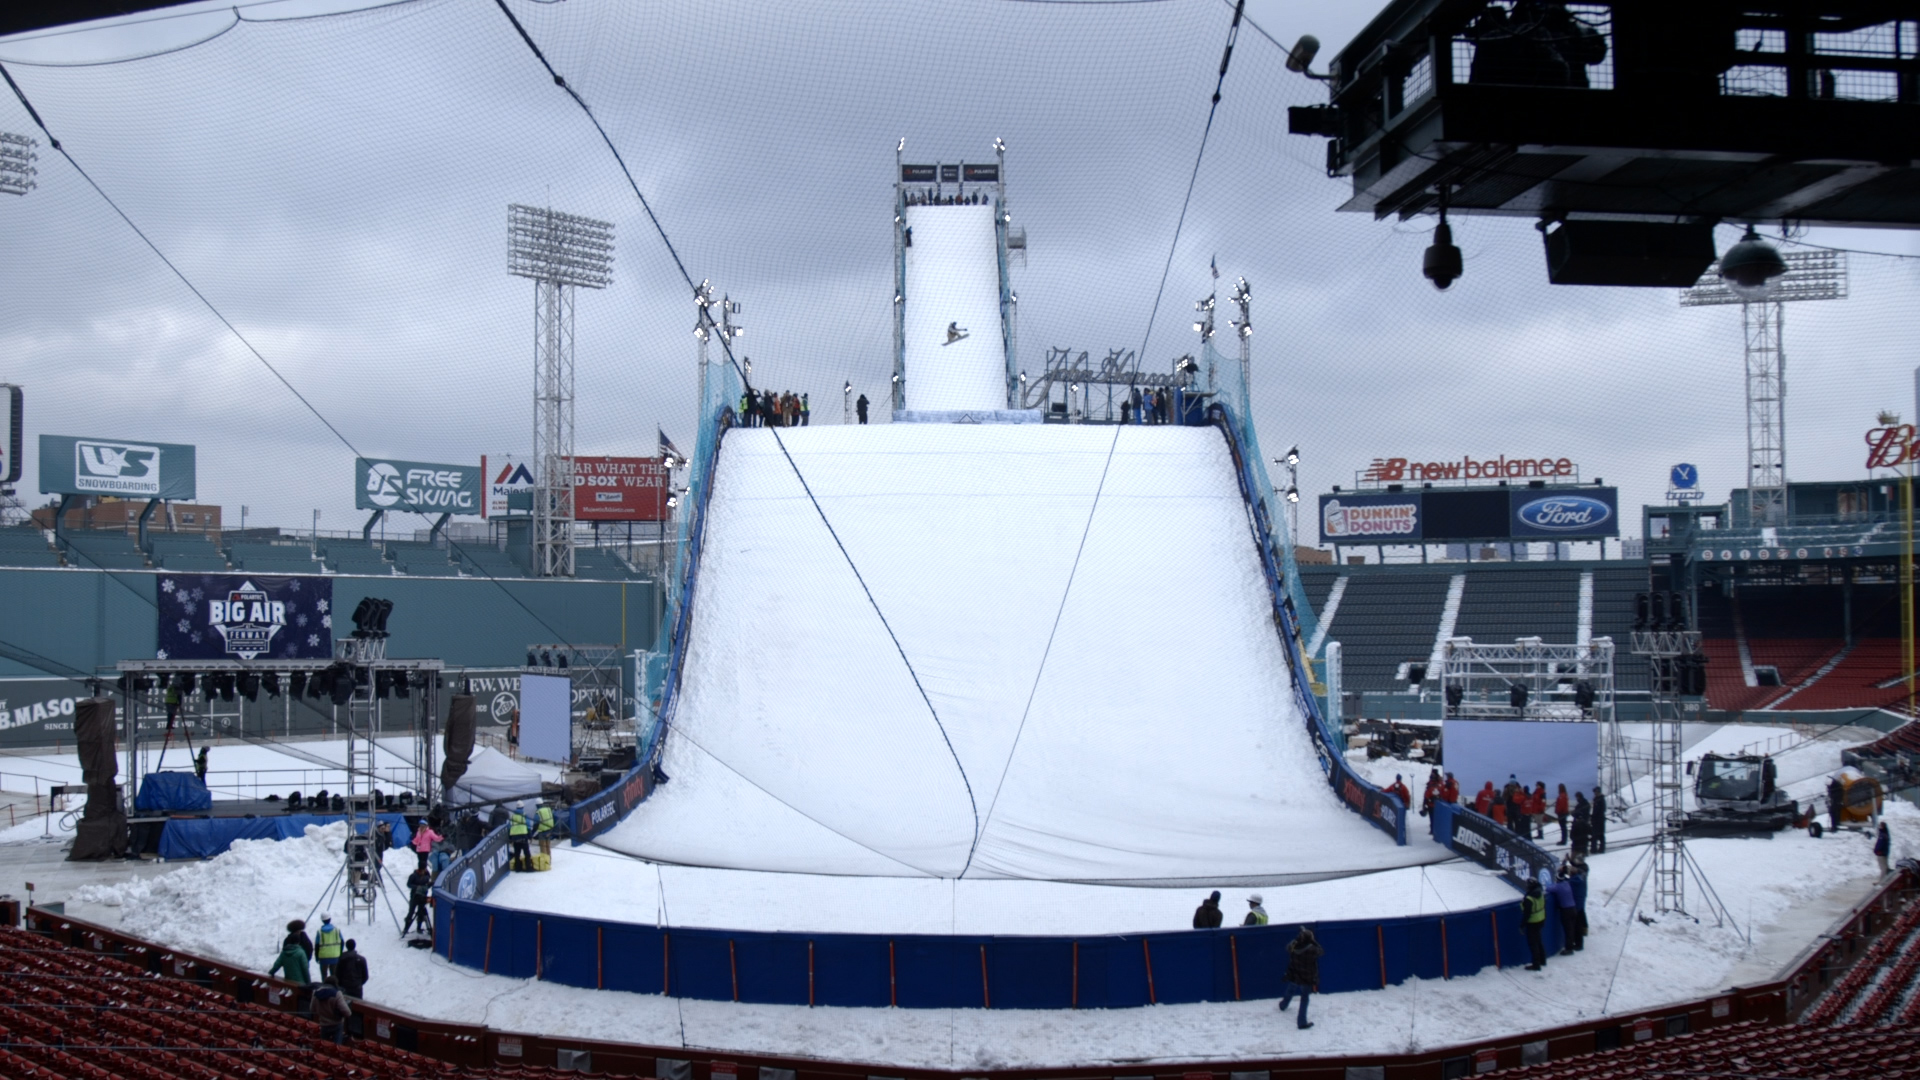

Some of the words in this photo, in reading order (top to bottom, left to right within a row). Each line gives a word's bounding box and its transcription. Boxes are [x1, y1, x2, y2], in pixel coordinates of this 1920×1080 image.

[595, 463, 636, 475] WHAT
[640, 463, 667, 475] THE
[1410, 461, 1461, 481] new
[1464, 454, 1572, 479] balance
[79, 478, 157, 491] SNOWBOARDING
[407, 469, 462, 488] FREE
[588, 475, 617, 487] SOX
[623, 476, 664, 488] WEAR
[404, 487, 472, 508] SKIING
[1350, 507, 1414, 520] DUNKIN'
[1536, 501, 1592, 524] Ford
[1350, 520, 1411, 533] DONUTS
[209, 600, 245, 624] BIG
[250, 600, 287, 625] AIR
[230, 631, 266, 639] FENWAY
[469, 678, 497, 692] F.W.
[498, 677, 521, 691] WE
[0, 697, 92, 730] B.MASO
[44, 723, 69, 731] SINCE
[1452, 825, 1492, 857] BOSE
